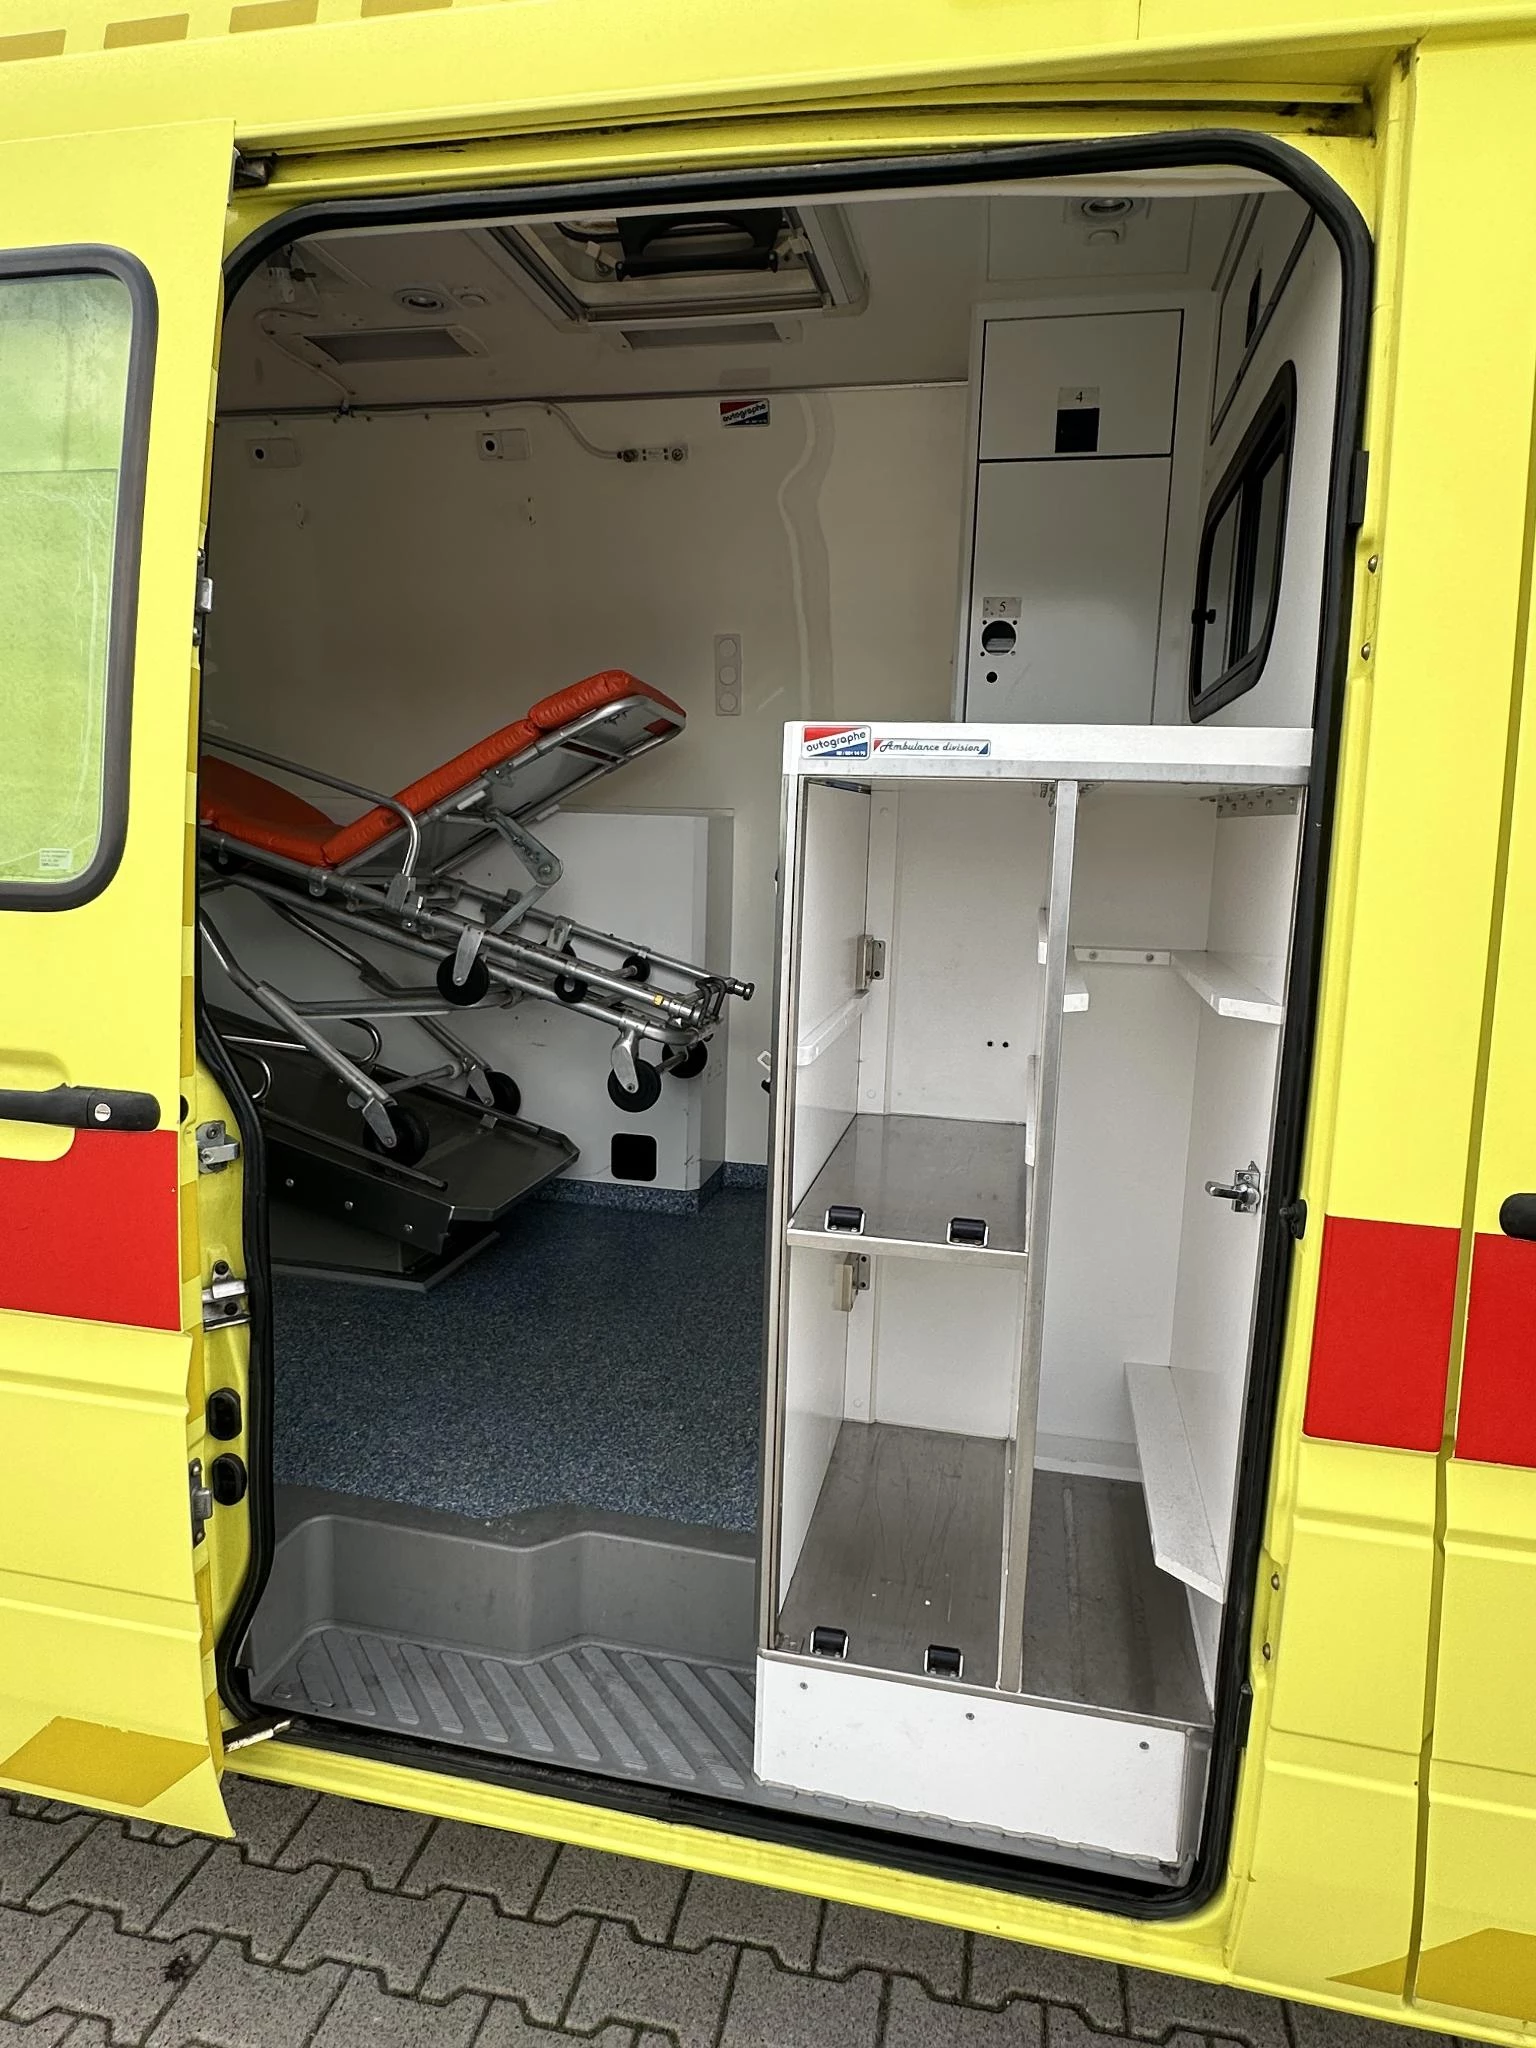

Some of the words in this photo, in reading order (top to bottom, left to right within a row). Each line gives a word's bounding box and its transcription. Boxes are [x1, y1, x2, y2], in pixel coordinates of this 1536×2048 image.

[1075, 391, 1083, 402] 4
[999, 601, 1006, 612] 5
[806, 731, 866, 752] autographe
[880, 740, 940, 753] Ambulance
[942, 741, 981, 753] division
